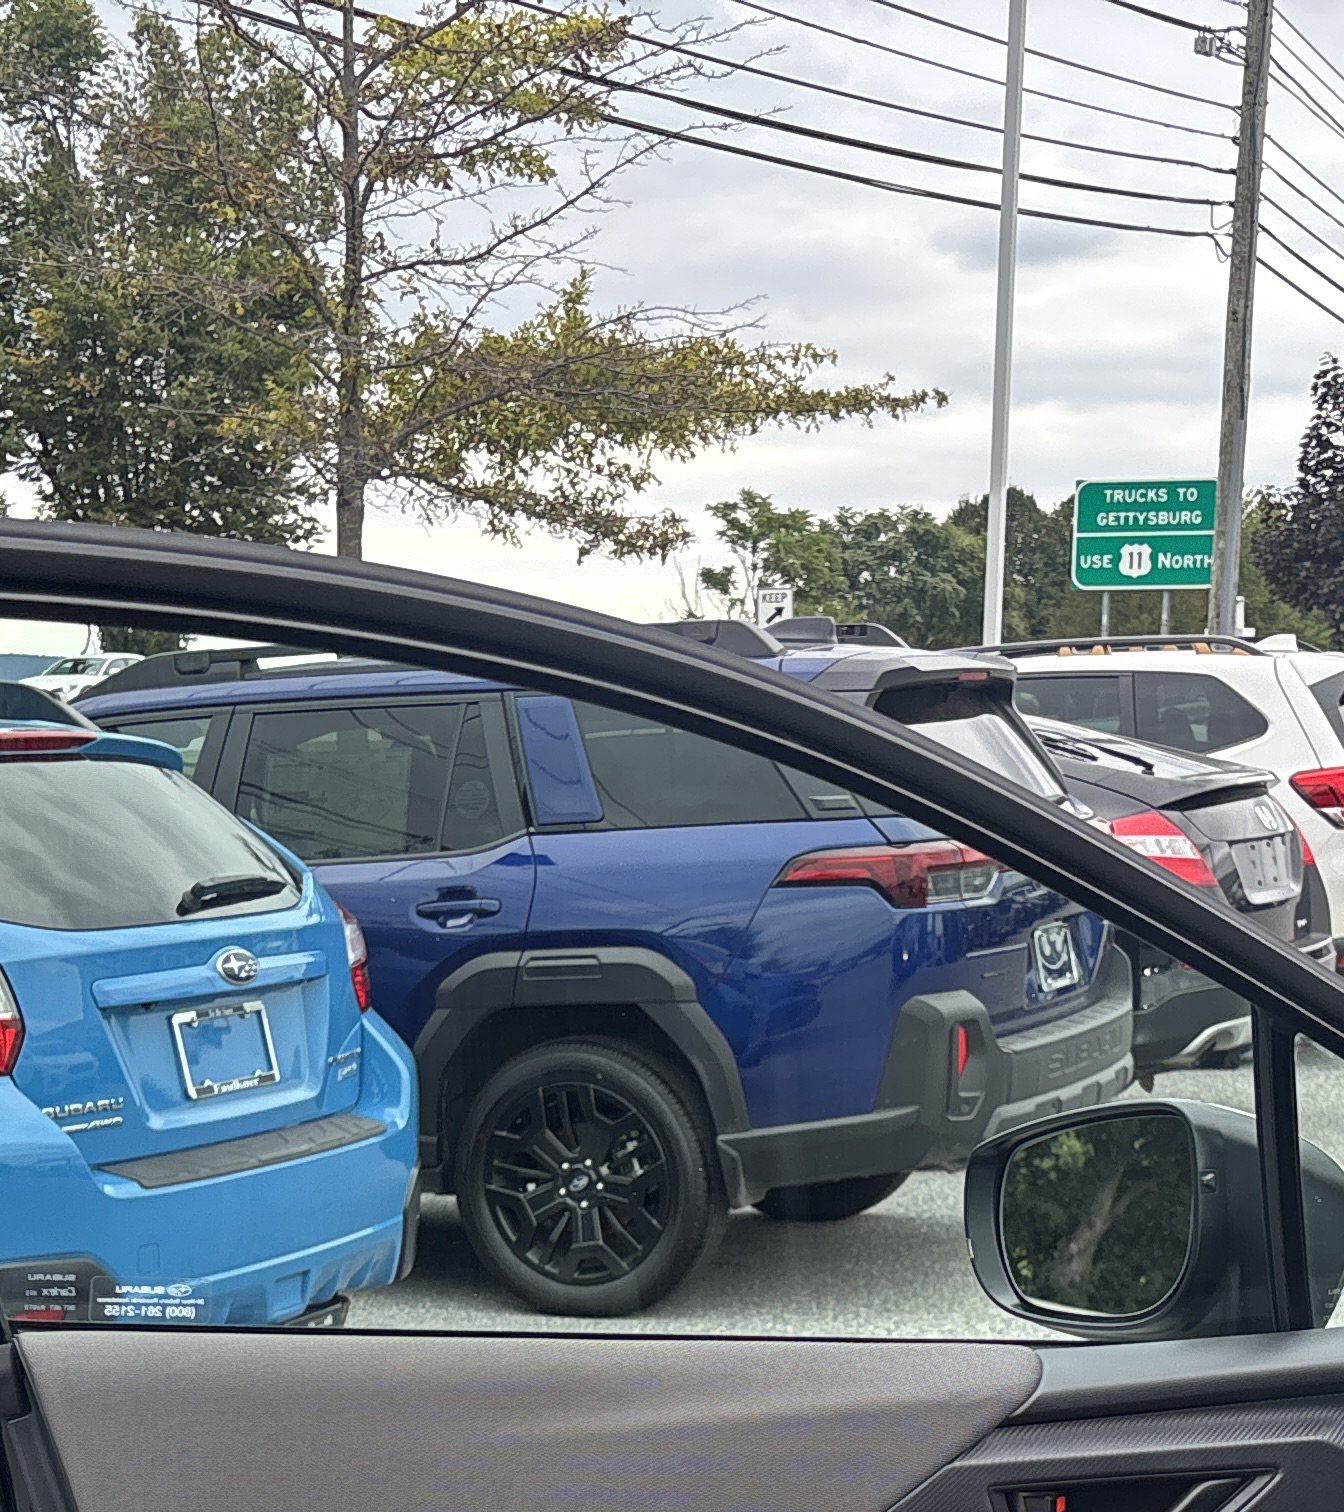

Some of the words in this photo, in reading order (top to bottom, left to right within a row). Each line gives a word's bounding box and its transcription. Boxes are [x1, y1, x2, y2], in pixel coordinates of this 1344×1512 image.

[1104, 488, 1168, 503] TRUCKS
[1177, 487, 1198, 502] TO
[1096, 511, 1203, 526] GETTYSBURG
[1080, 554, 1113, 569] USE
[1128, 551, 1143, 570] 11
